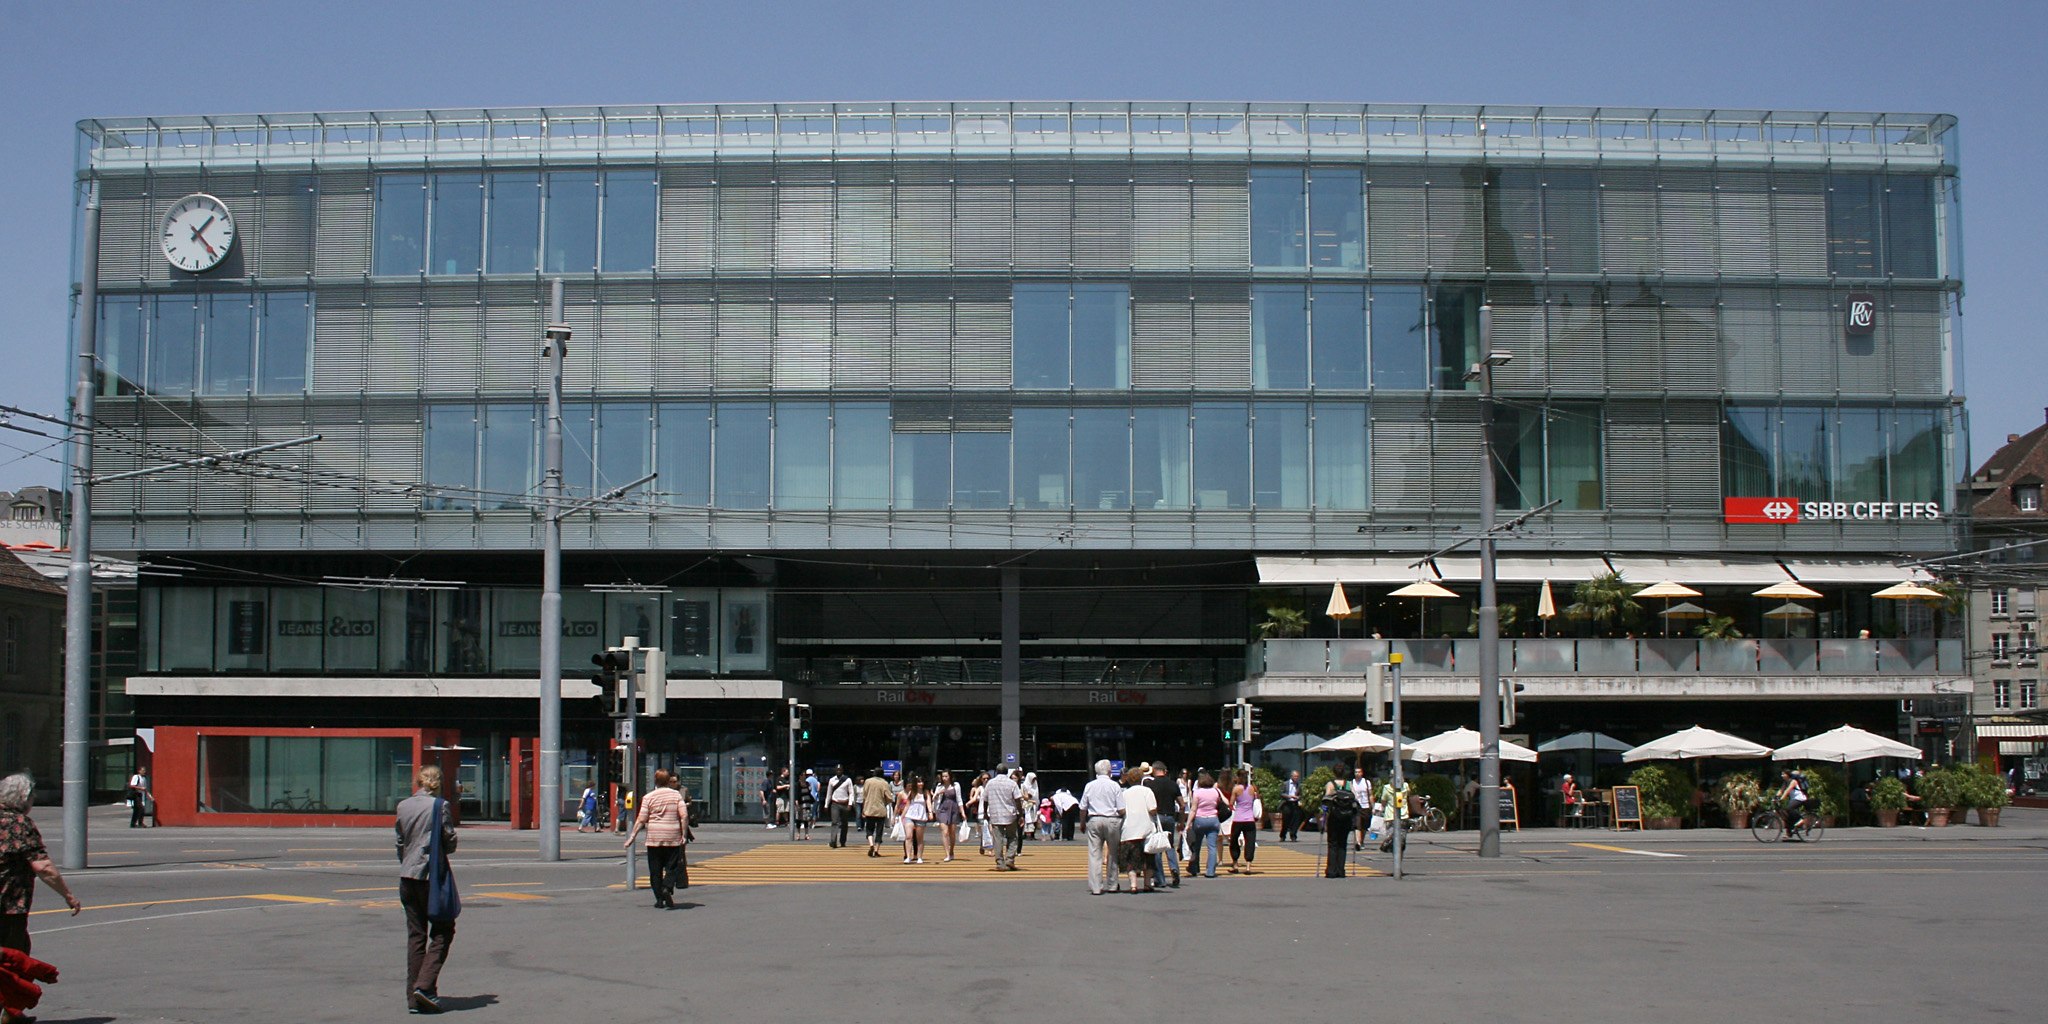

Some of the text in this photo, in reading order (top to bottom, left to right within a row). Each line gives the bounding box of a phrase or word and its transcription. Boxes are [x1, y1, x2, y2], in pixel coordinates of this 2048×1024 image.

[1804, 501, 1939, 520] SBB CFF FFS
[280, 623, 323, 635] JEANS
[352, 623, 373, 635] CO
[575, 624, 596, 635] CO
